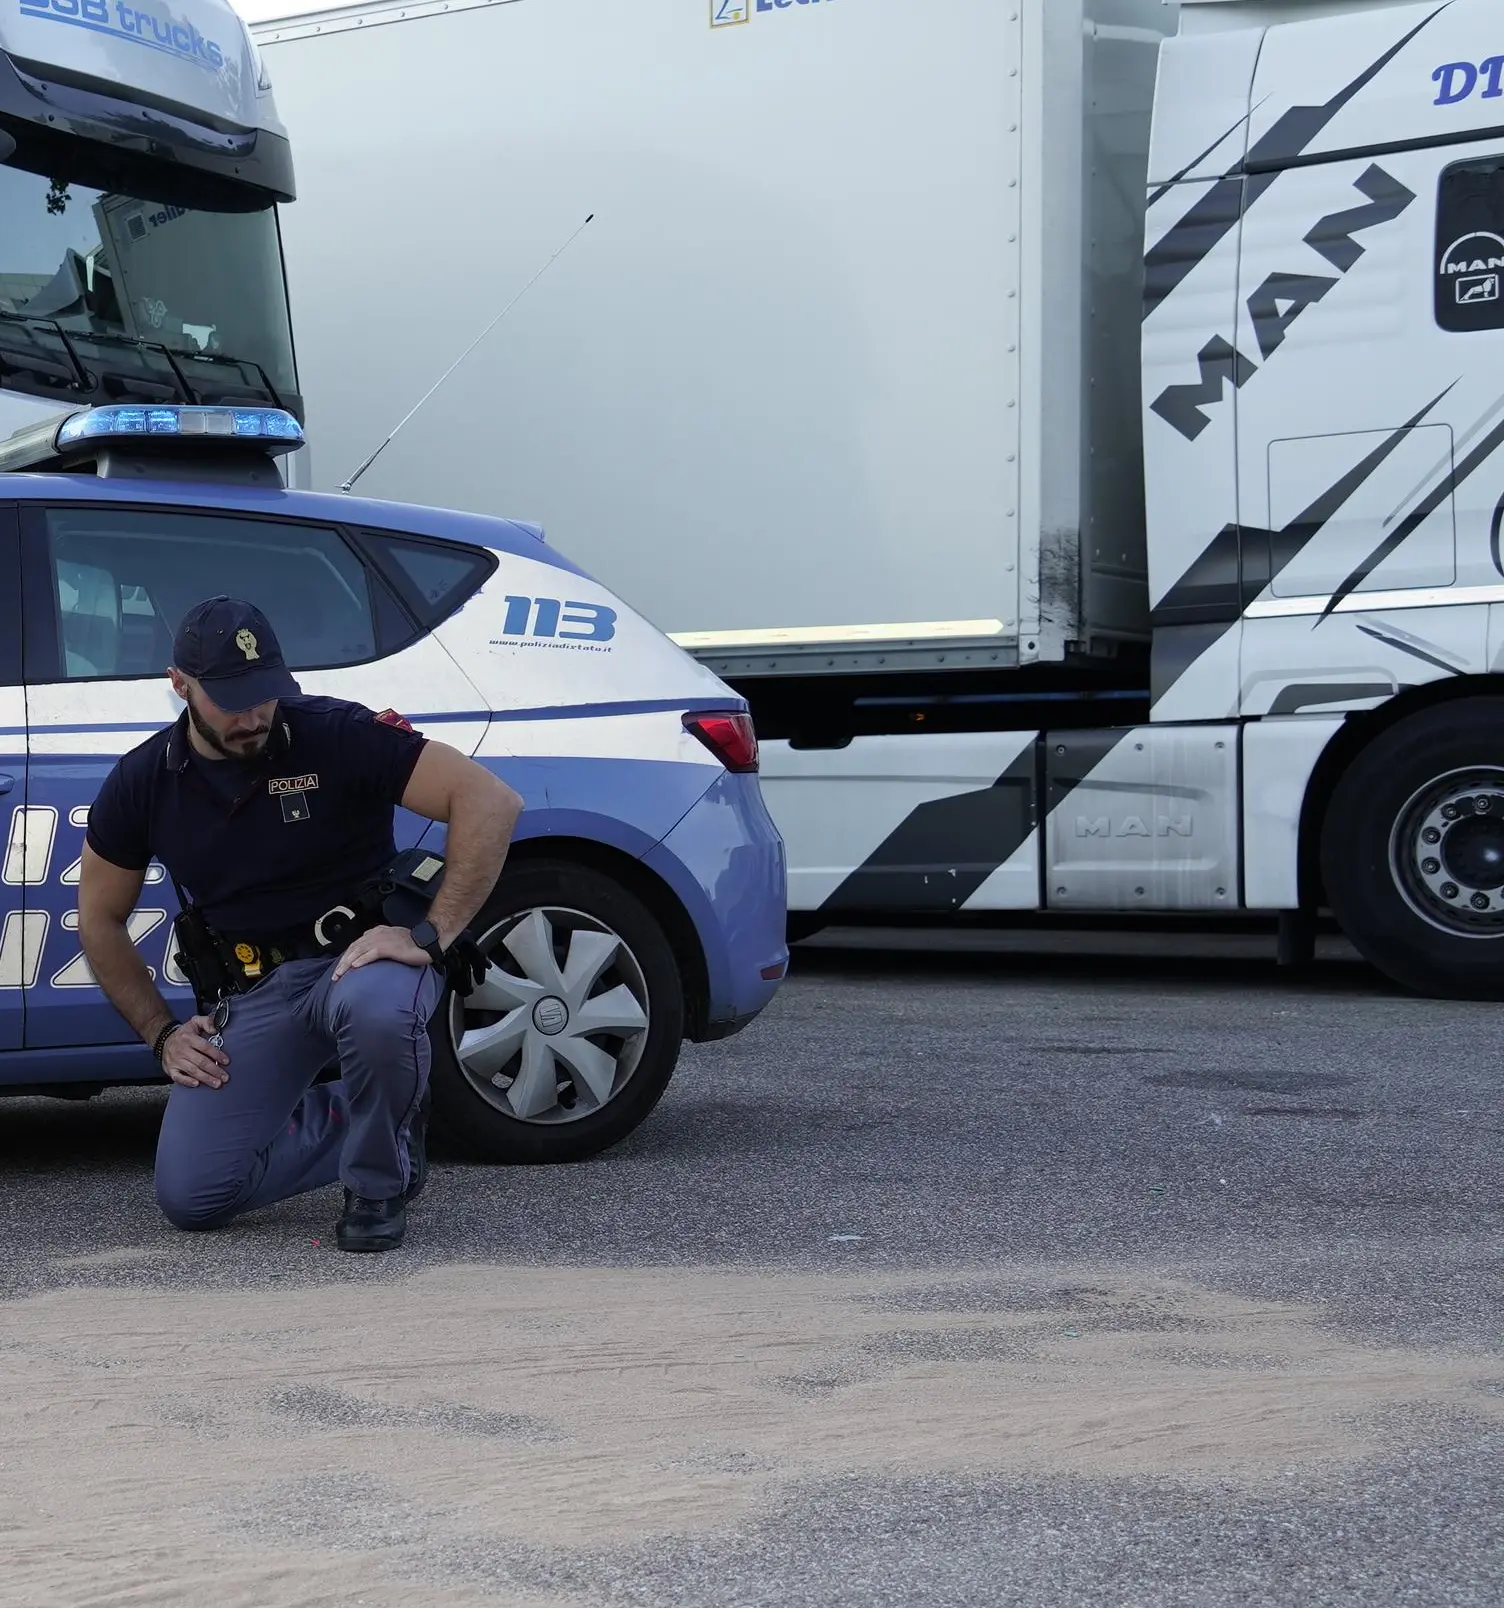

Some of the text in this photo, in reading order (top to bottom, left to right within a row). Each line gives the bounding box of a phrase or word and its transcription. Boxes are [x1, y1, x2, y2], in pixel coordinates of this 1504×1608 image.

[116, 2, 223, 68] trucks
[1447, 256, 1504, 274] MAN
[1149, 162, 1417, 442] MAN
[502, 595, 618, 642] 113
[271, 776, 316, 792] POLIZIA
[1075, 815, 1194, 838] MAN
